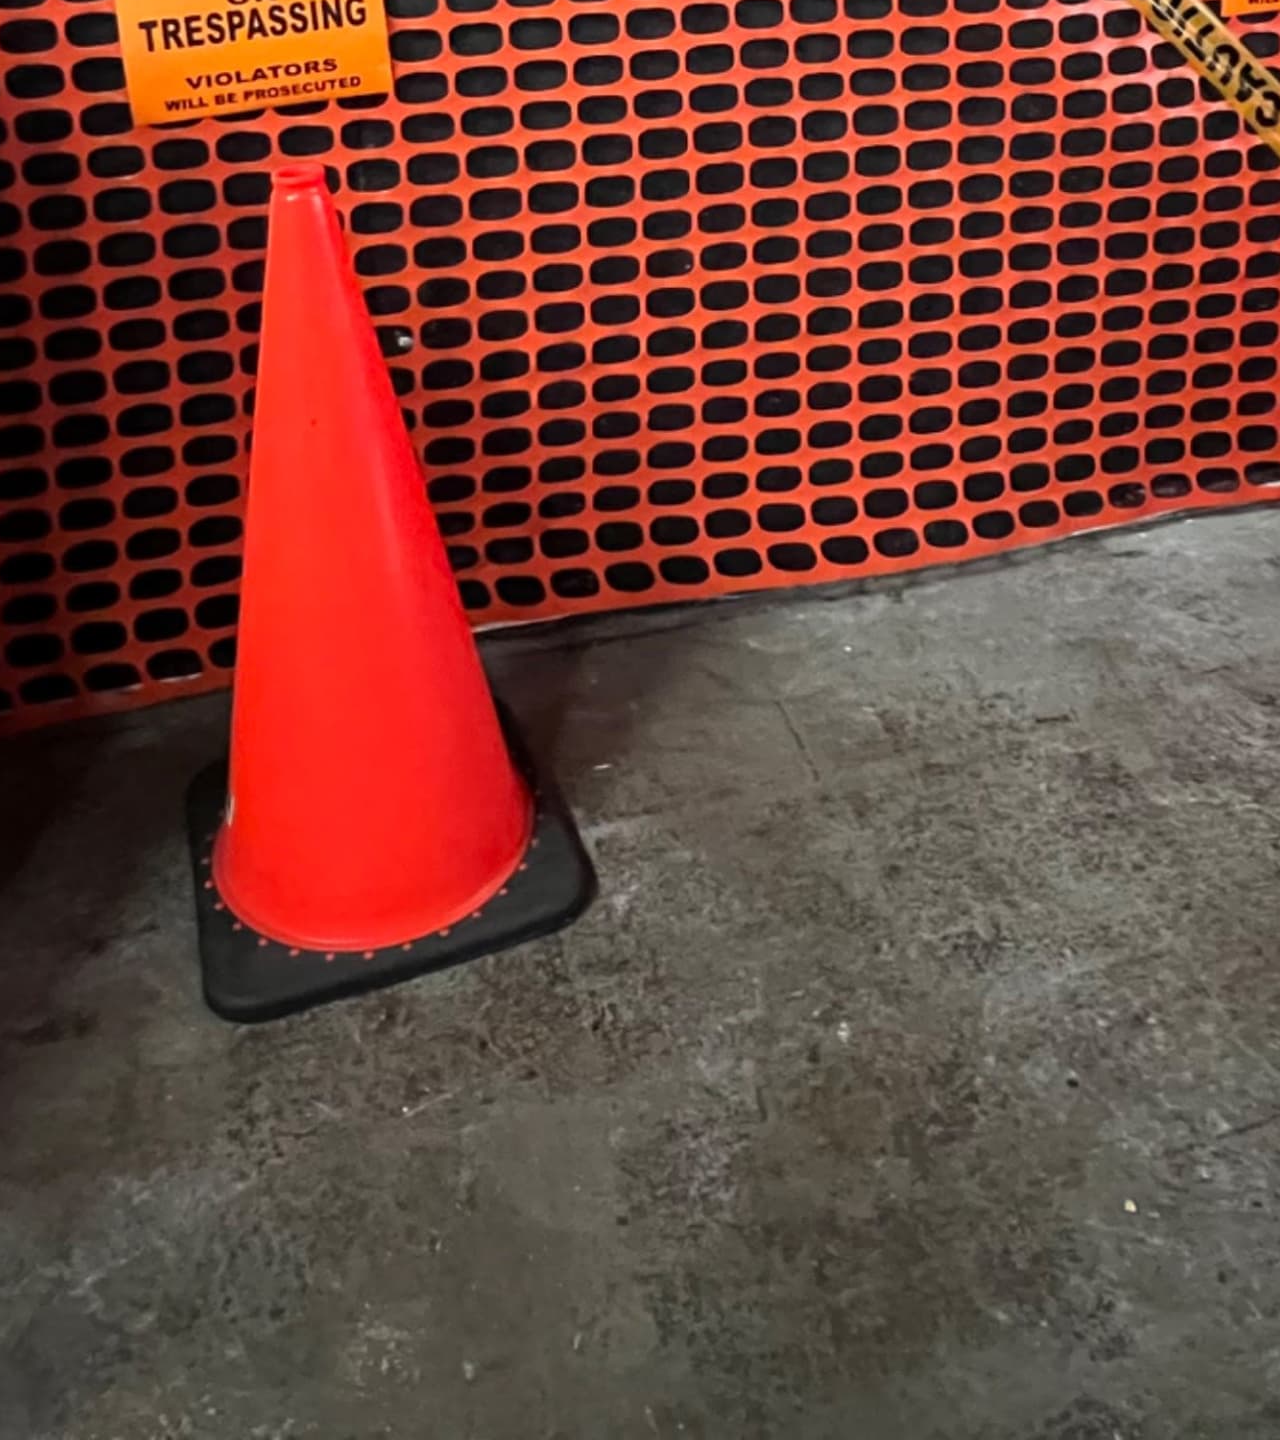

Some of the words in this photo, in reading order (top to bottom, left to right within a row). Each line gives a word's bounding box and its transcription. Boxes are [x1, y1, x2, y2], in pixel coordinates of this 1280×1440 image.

[185, 59, 337, 89] VIOLATORS
[165, 96, 208, 112] WILL
[214, 92, 236, 105] BE
[243, 76, 360, 102] PROSECUTED
